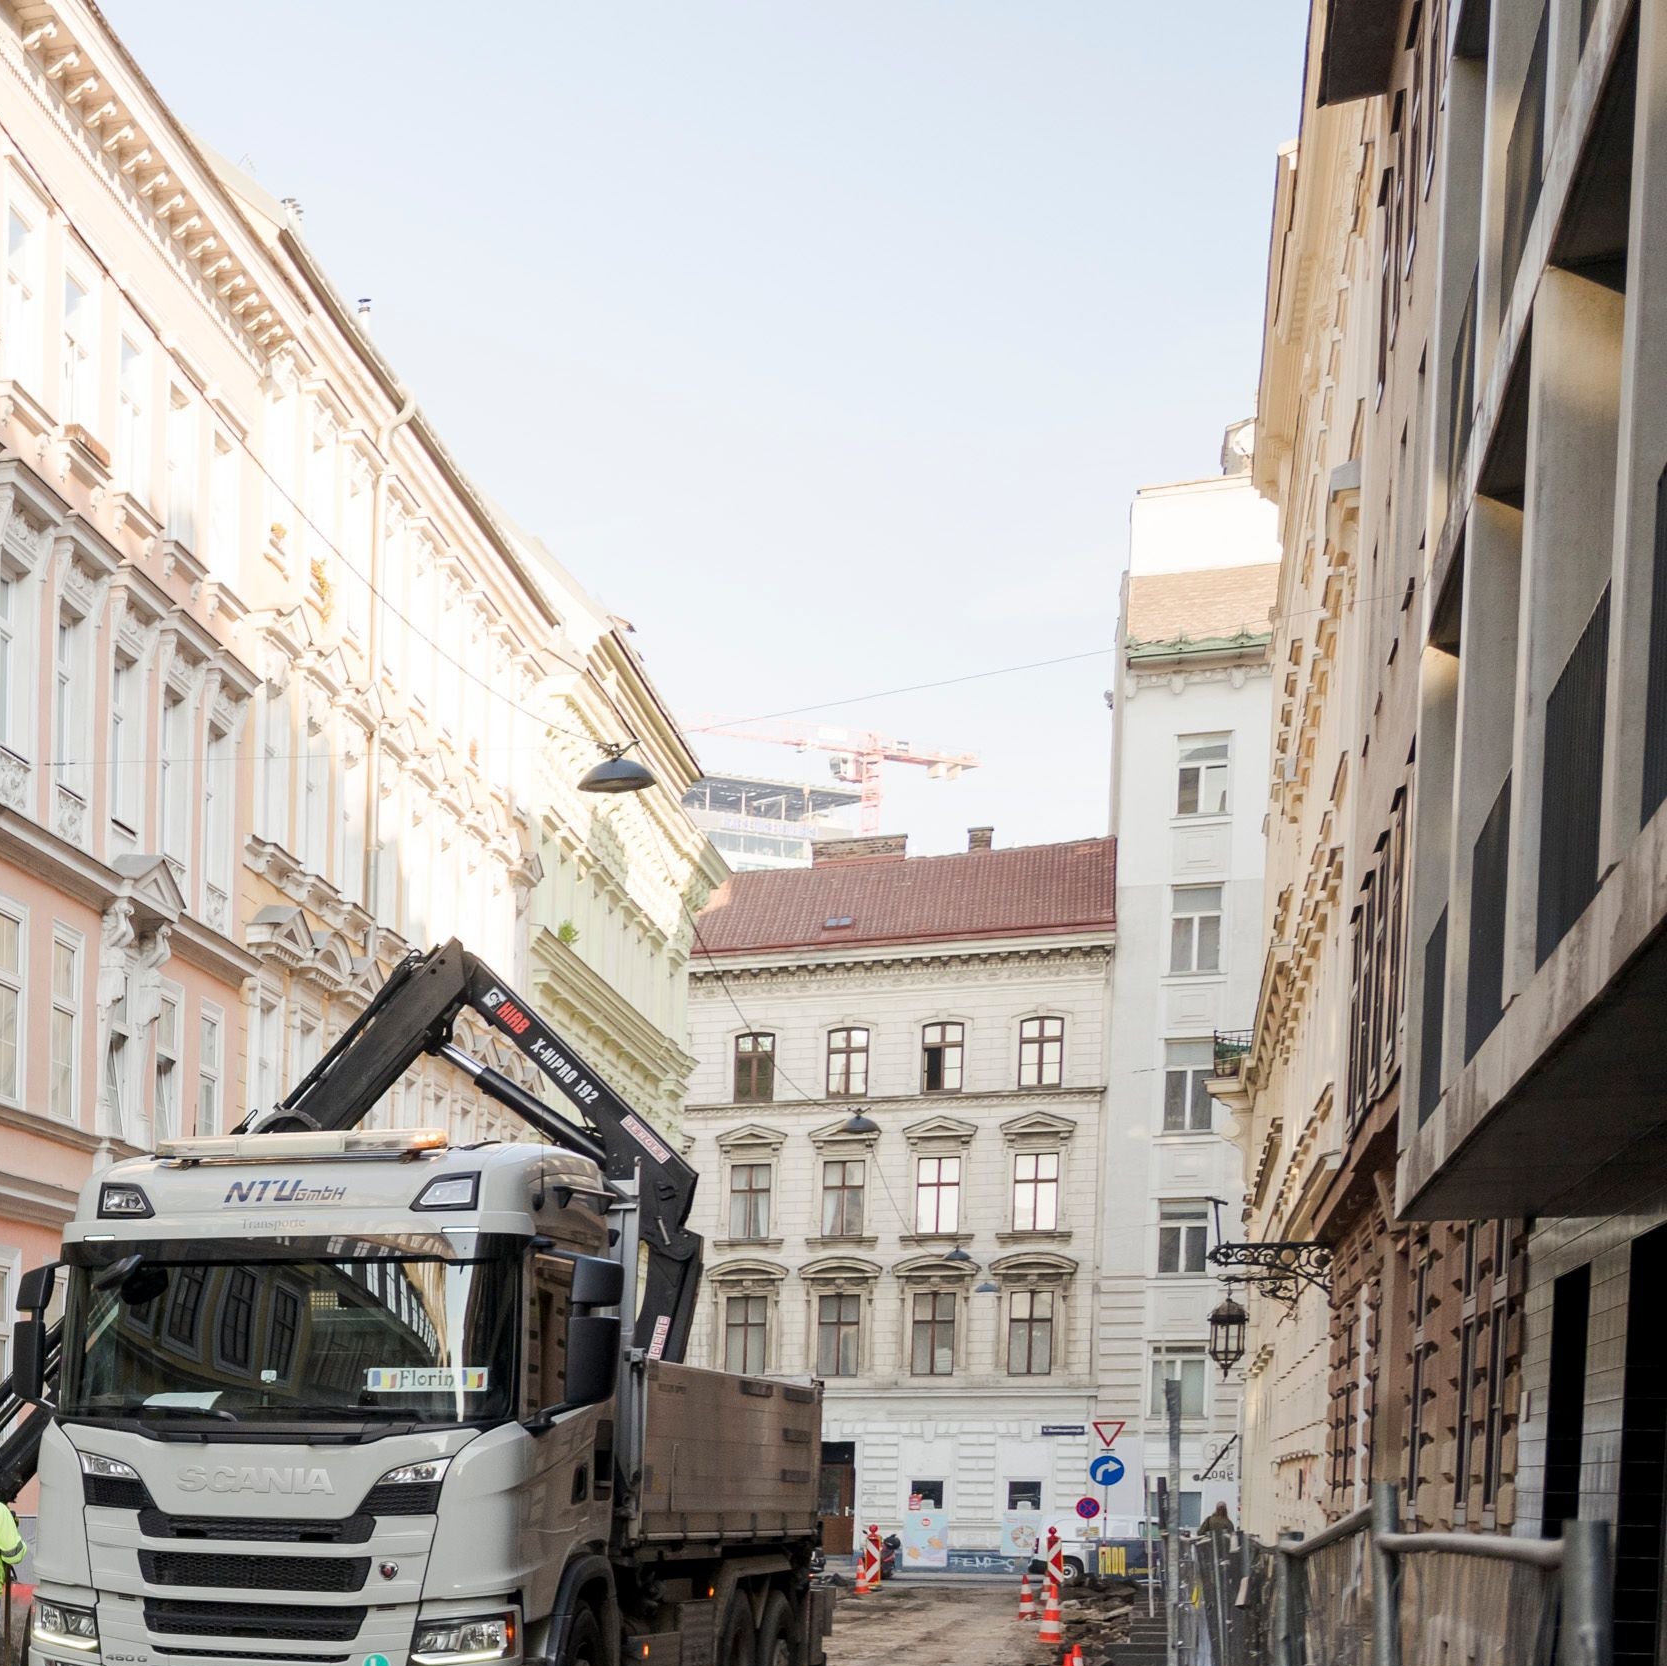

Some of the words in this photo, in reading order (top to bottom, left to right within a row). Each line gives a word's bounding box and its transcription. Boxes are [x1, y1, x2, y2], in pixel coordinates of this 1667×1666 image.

[496, 1001, 531, 1035] HIAB
[530, 1037, 579, 1084] X-HIPRO
[573, 1079, 600, 1105] 192
[241, 1217, 307, 1231] Transporte
[398, 1369, 456, 1390] Florin
[176, 1464, 336, 1496] SCANIA
